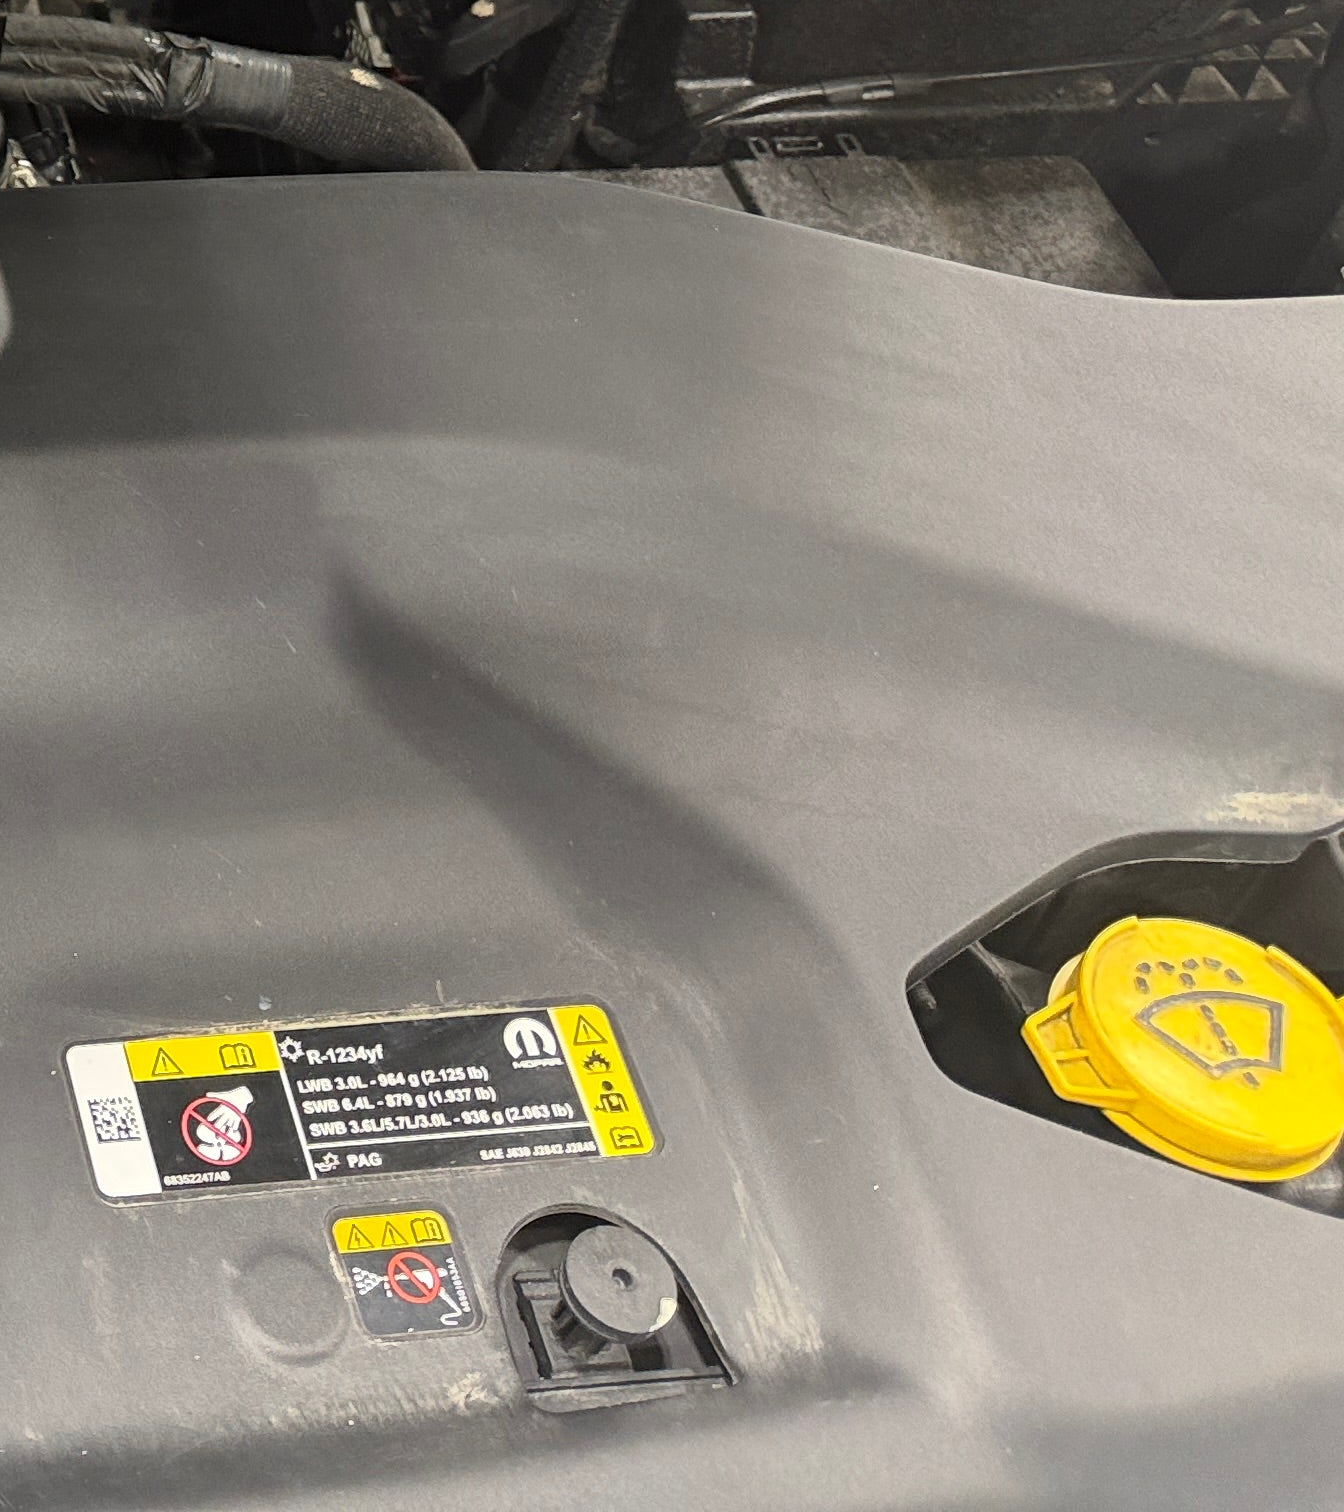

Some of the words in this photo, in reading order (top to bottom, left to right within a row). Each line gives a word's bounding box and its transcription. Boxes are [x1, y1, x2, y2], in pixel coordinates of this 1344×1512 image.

[305, 1043, 384, 1066] R-1234yf
[296, 1077, 333, 1094] LWB
[334, 1075, 368, 1091] 3.0L
[407, 1073, 420, 1088] g
[420, 1067, 466, 1087] (2.125
[466, 1065, 489, 1082] lb)
[301, 1098, 341, 1114] SWB
[341, 1096, 376, 1111] 6.4L
[415, 1094, 428, 1109] g
[428, 1087, 472, 1107] (1.937
[474, 1085, 497, 1103] lb)
[308, 1120, 348, 1137] SWB
[491, 1111, 504, 1126] g
[550, 1103, 574, 1119] lb)
[346, 1152, 383, 1169] PAG
[479, 1148, 505, 1161] SAE
